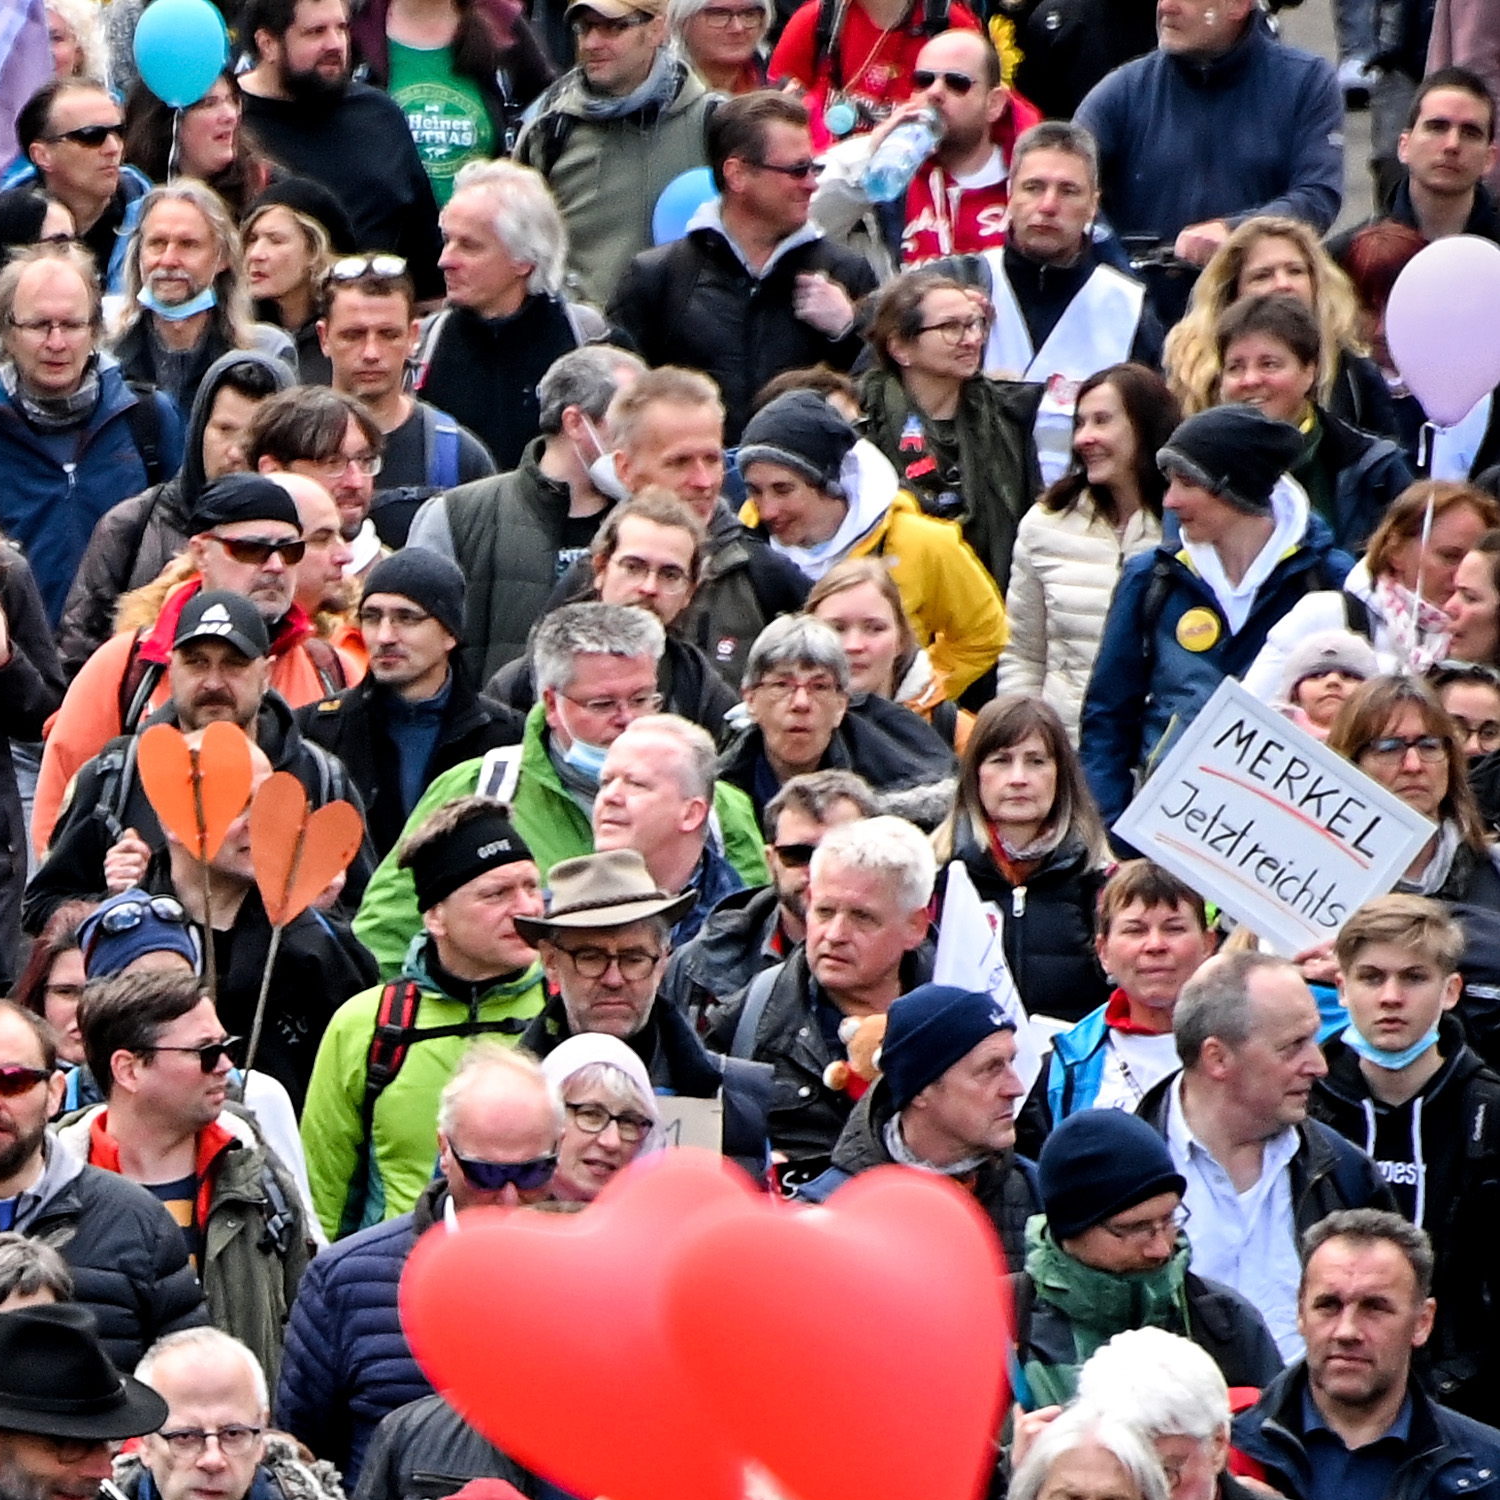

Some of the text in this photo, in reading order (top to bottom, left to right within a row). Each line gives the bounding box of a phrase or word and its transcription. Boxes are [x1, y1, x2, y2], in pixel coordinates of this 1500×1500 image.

[408, 114, 471, 130] Heiner
[411, 130, 473, 147] LTRAS
[1212, 718, 1376, 861] MERKEL
